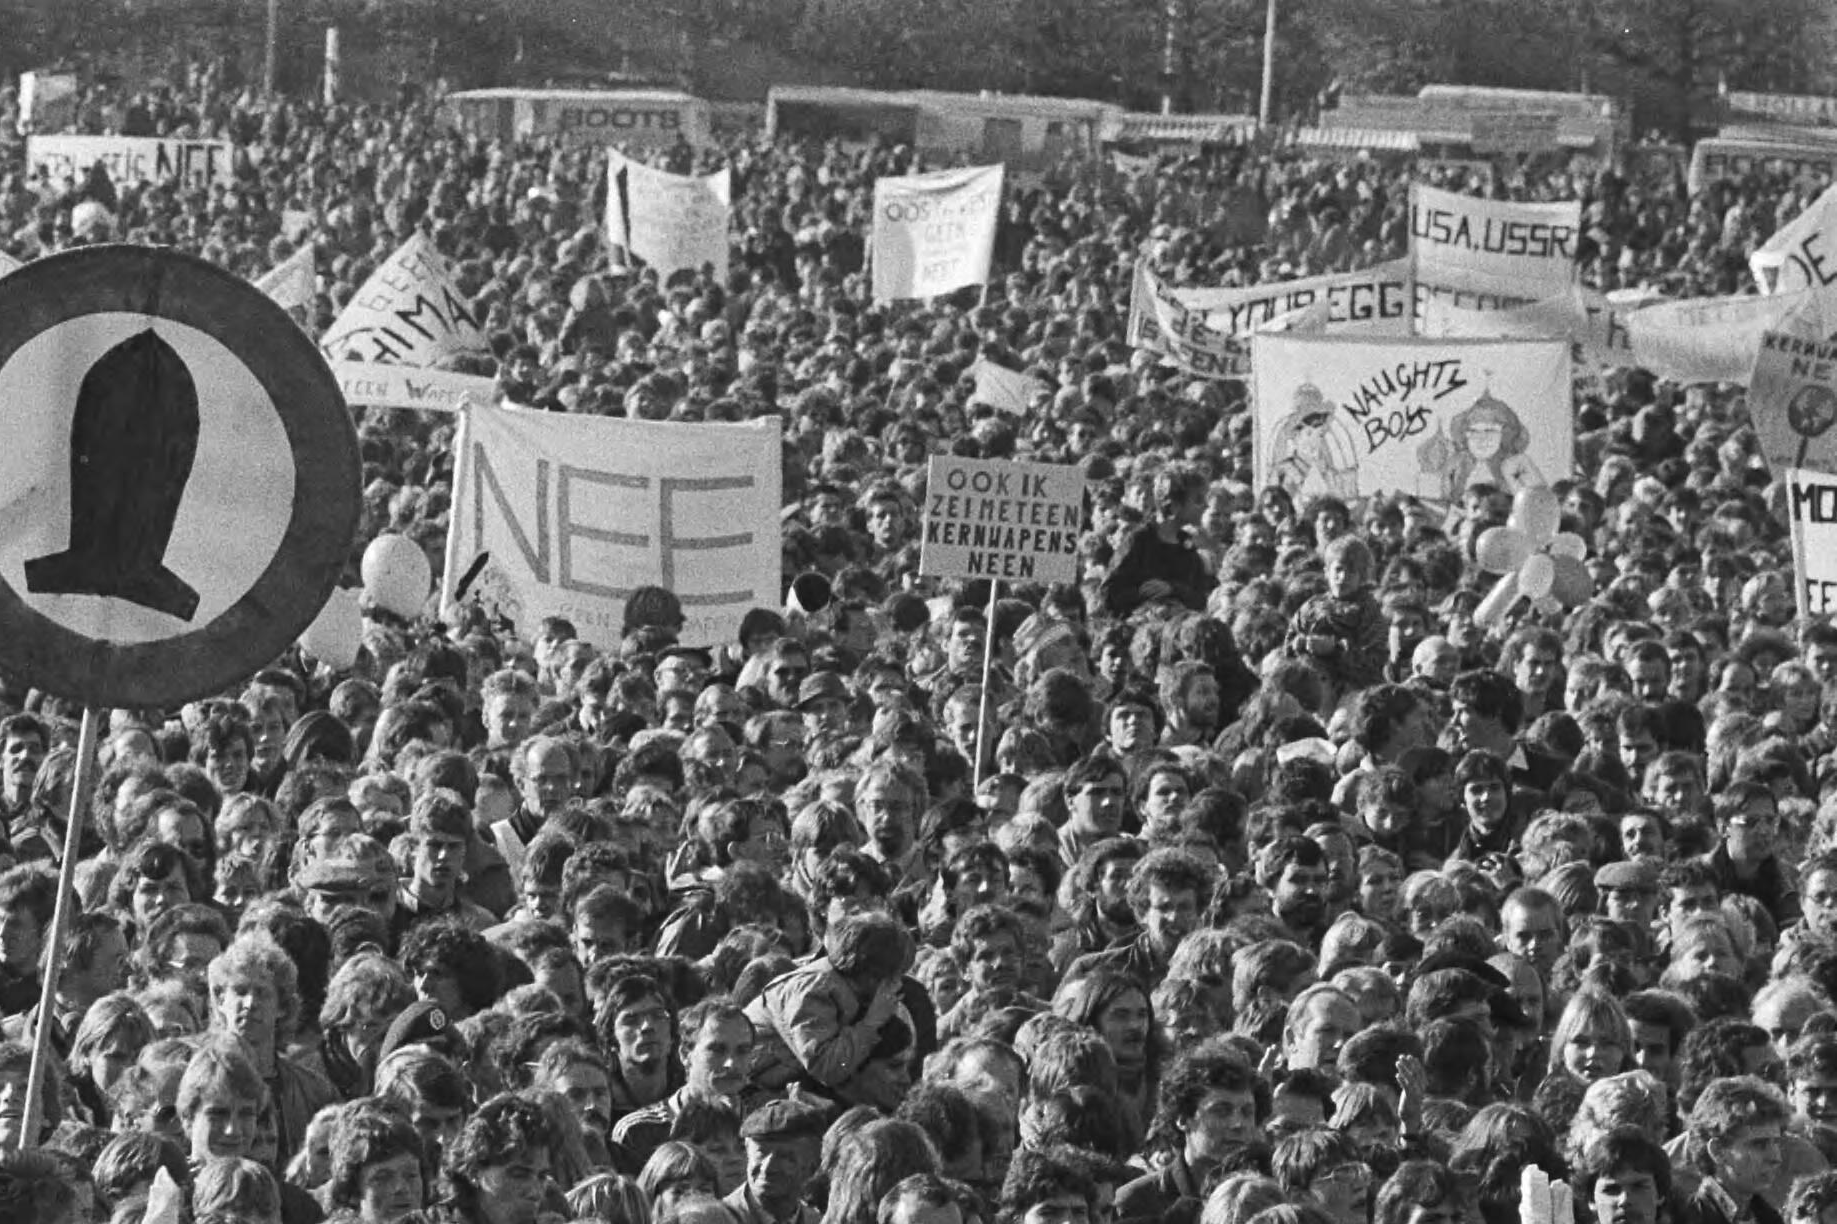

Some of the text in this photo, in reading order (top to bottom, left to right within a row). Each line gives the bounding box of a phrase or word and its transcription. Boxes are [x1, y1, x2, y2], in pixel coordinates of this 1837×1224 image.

[1343, 359, 1467, 423] NAUGHTY
[1365, 405, 1432, 454] BOYS
[948, 469, 1047, 498] OOK IK
[473, 440, 754, 605] NEE
[979, 498, 1079, 527] METEEN
[927, 521, 1078, 554] KERNWAPENS
[967, 551, 1035, 578] NEEN
